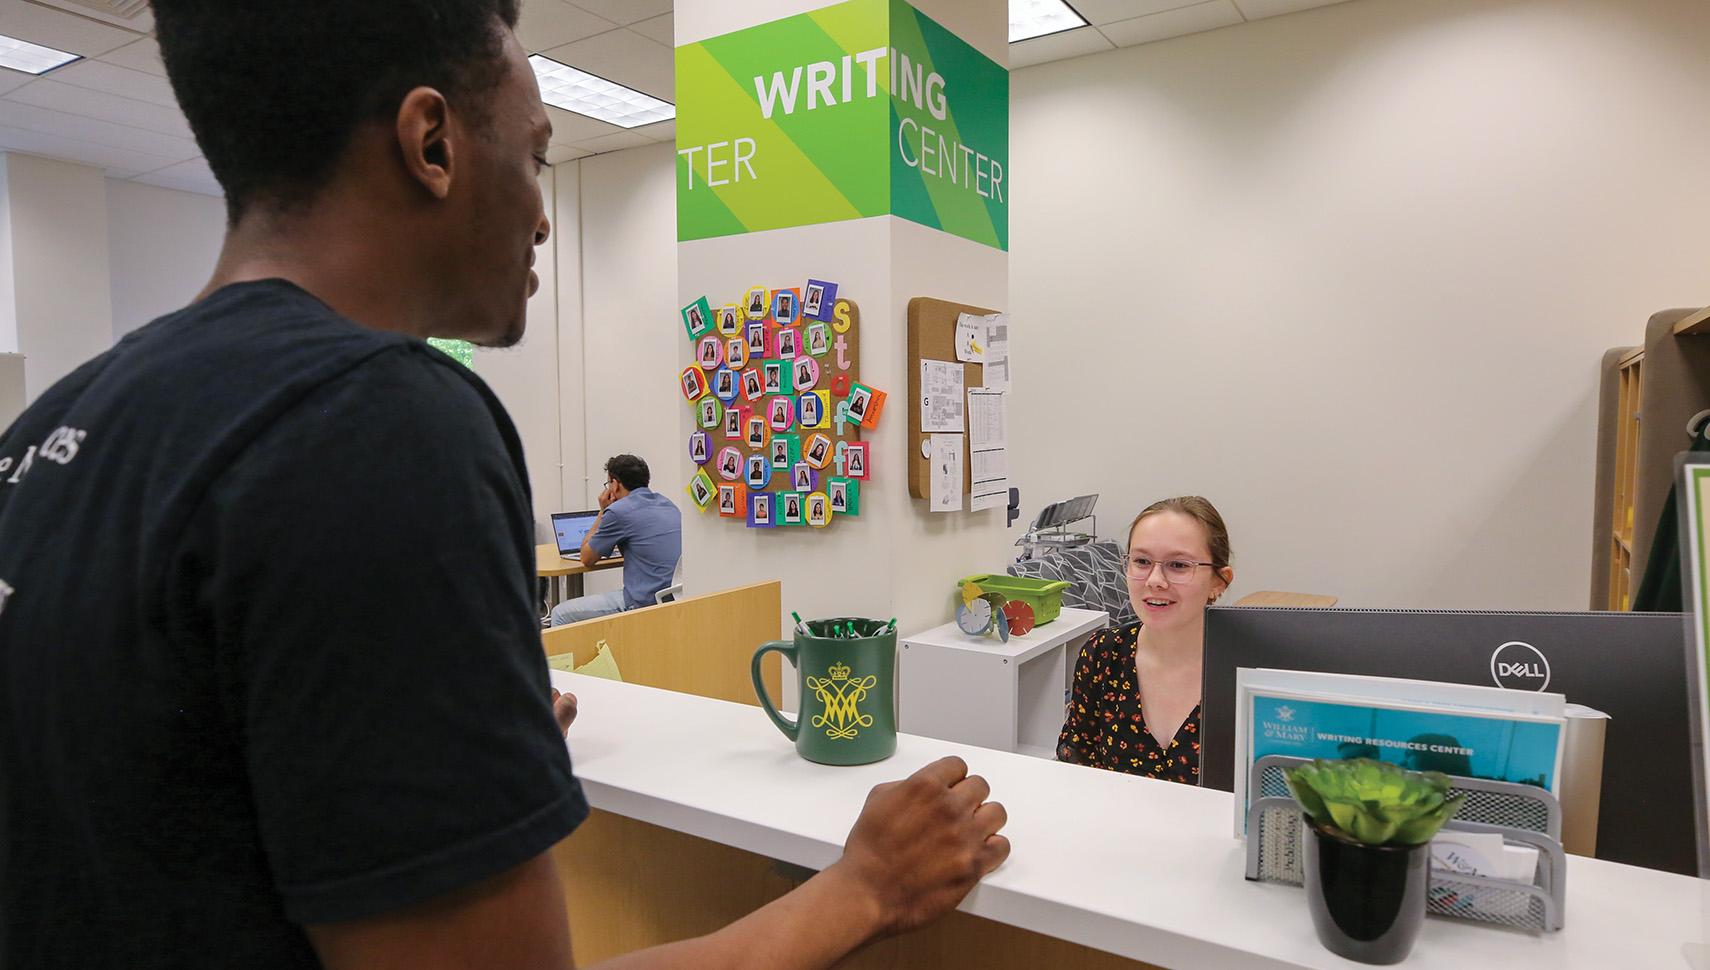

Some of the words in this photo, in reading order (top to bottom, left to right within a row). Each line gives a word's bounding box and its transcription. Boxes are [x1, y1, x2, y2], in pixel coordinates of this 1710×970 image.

[754, 46, 947, 120] WRITING
[678, 137, 757, 190] TER
[898, 117, 1004, 203] CENTER
[1498, 662, 1544, 678] DELL
[1263, 721, 1308, 733] WILLIAM
[1275, 731, 1307, 742] MARY
[1317, 732, 1363, 745] WRITING
[1365, 737, 1428, 752] RESOURCES
[1429, 744, 1474, 757] CENTER
